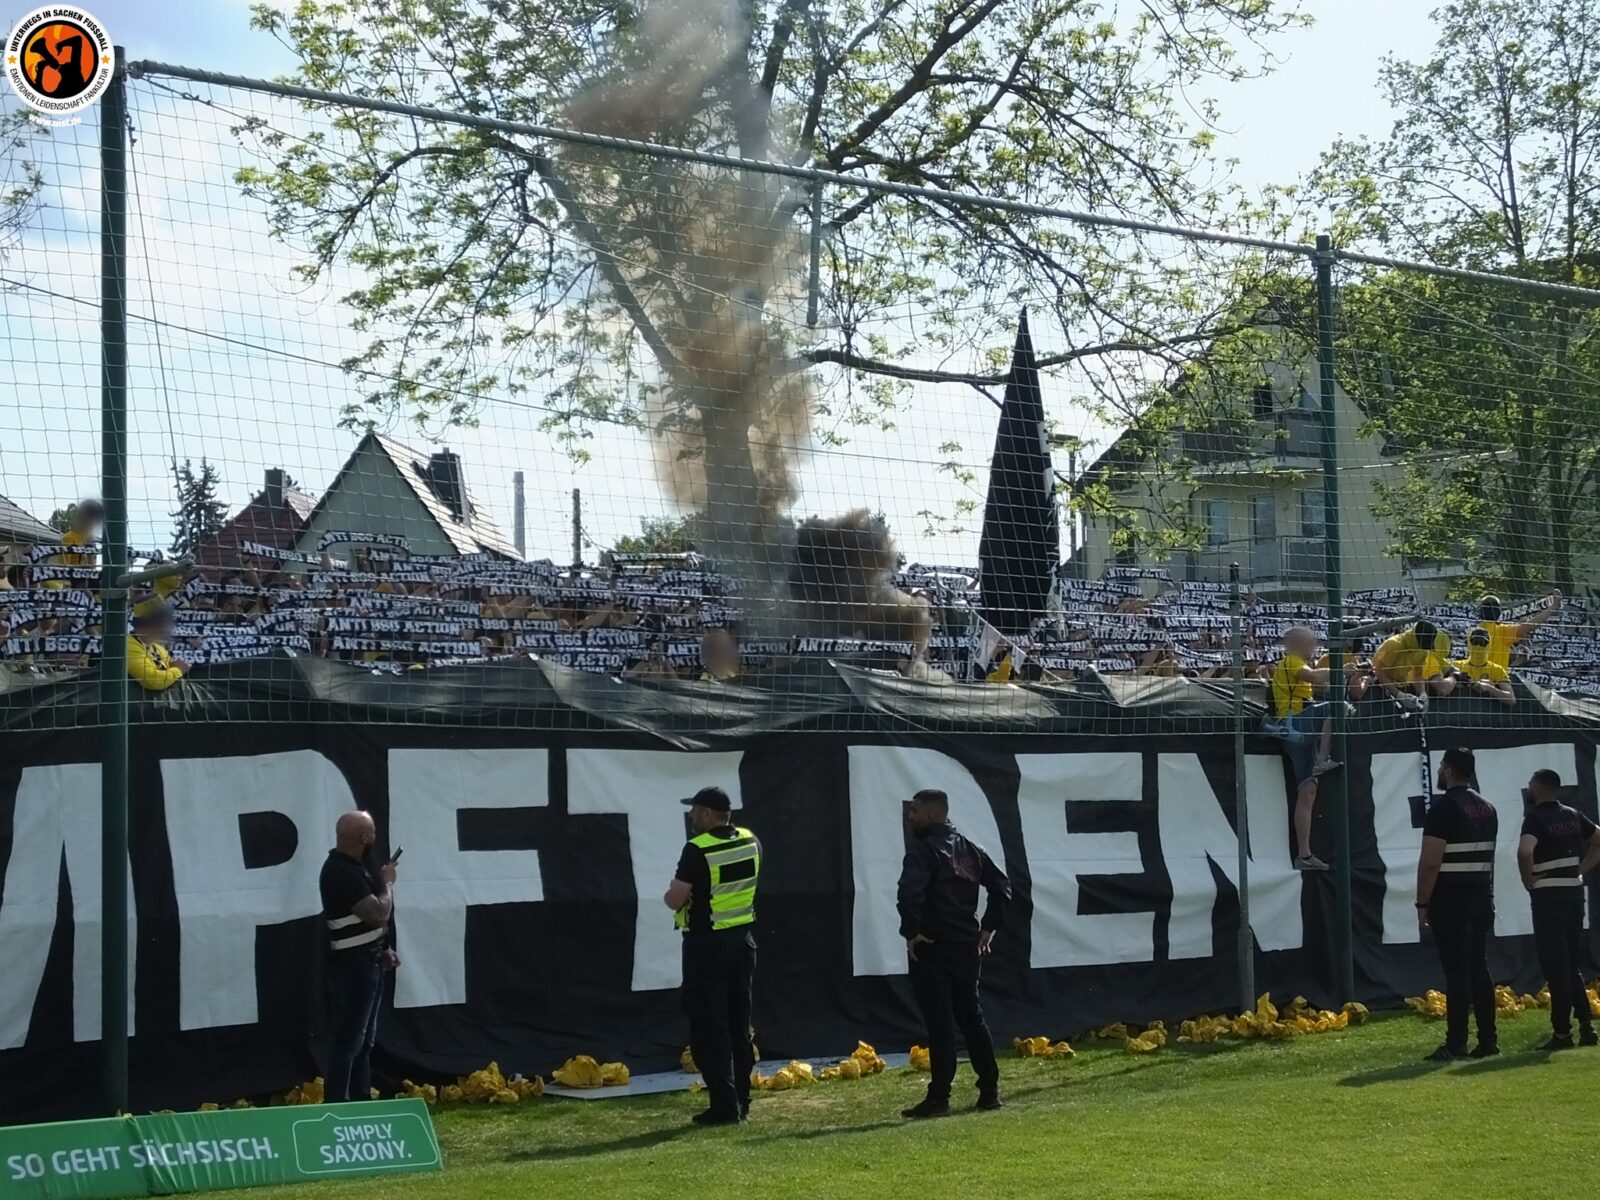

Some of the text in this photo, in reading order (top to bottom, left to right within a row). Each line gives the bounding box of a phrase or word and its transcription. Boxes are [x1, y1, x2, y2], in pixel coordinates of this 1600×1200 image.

[45, 637, 80, 653] BSG
[418, 640, 481, 656] ACTION
[847, 745, 1303, 978] DEN
[332, 1122, 393, 1142] SIMPLY
[7, 1137, 280, 1181] SO GEHT SÄCHSISCH.
[319, 1139, 413, 1165] SAXONY.
